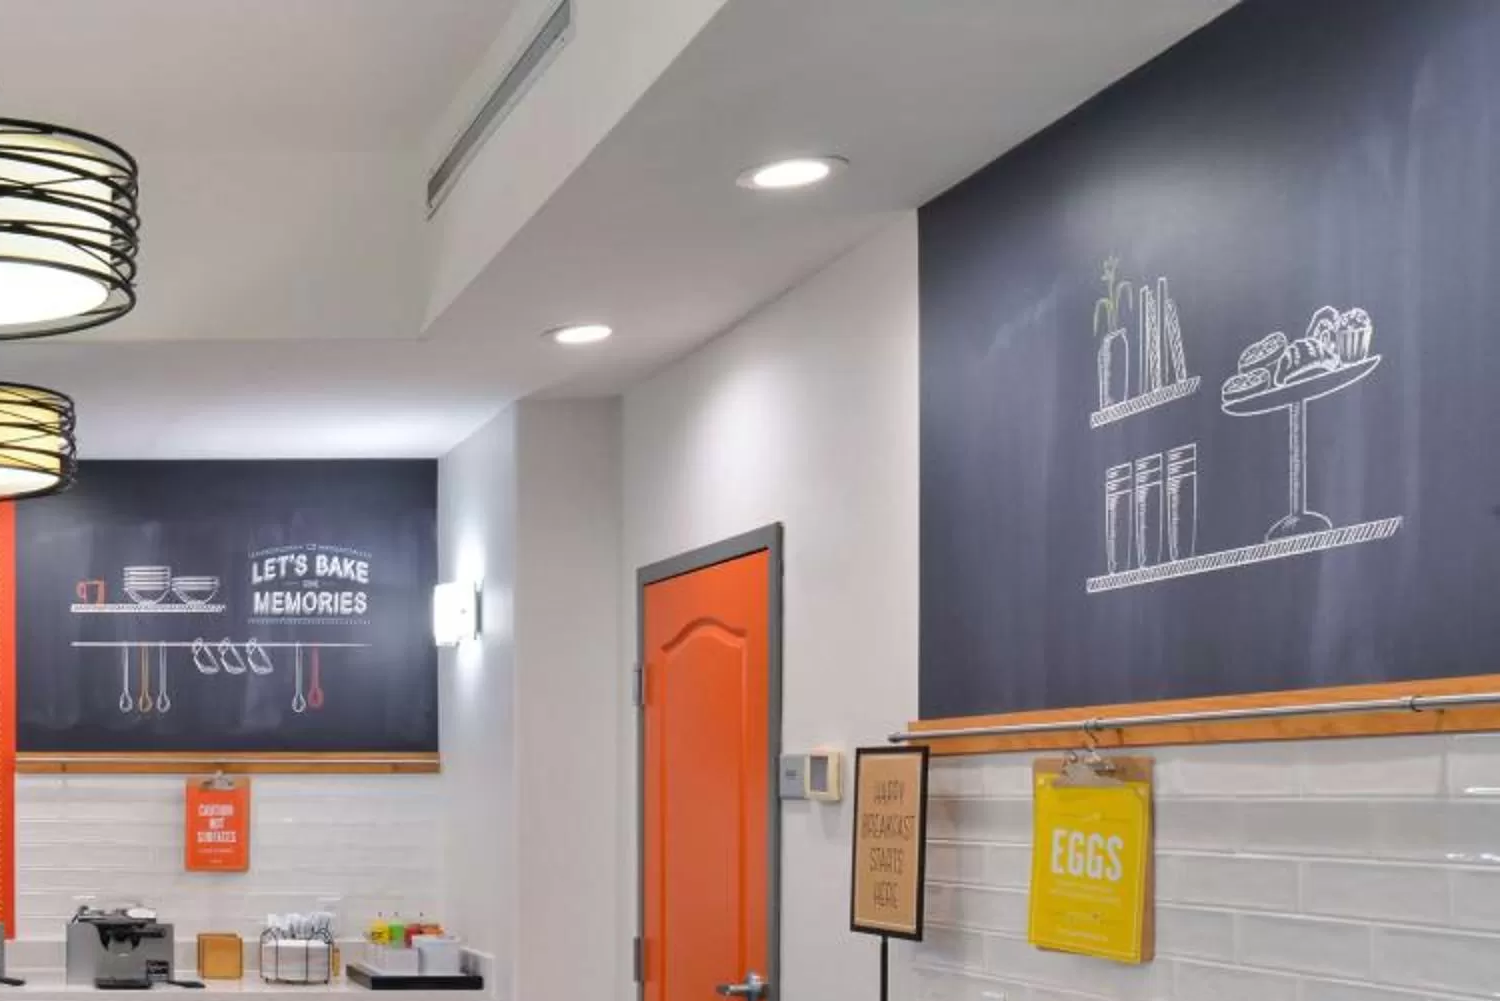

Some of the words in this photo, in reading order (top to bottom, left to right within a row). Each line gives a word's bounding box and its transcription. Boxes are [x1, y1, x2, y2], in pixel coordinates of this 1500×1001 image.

[251, 553, 308, 585] LET'S
[315, 553, 370, 584] BAKE
[253, 591, 368, 615] MEMORIES
[1050, 828, 1124, 881] EGGS
